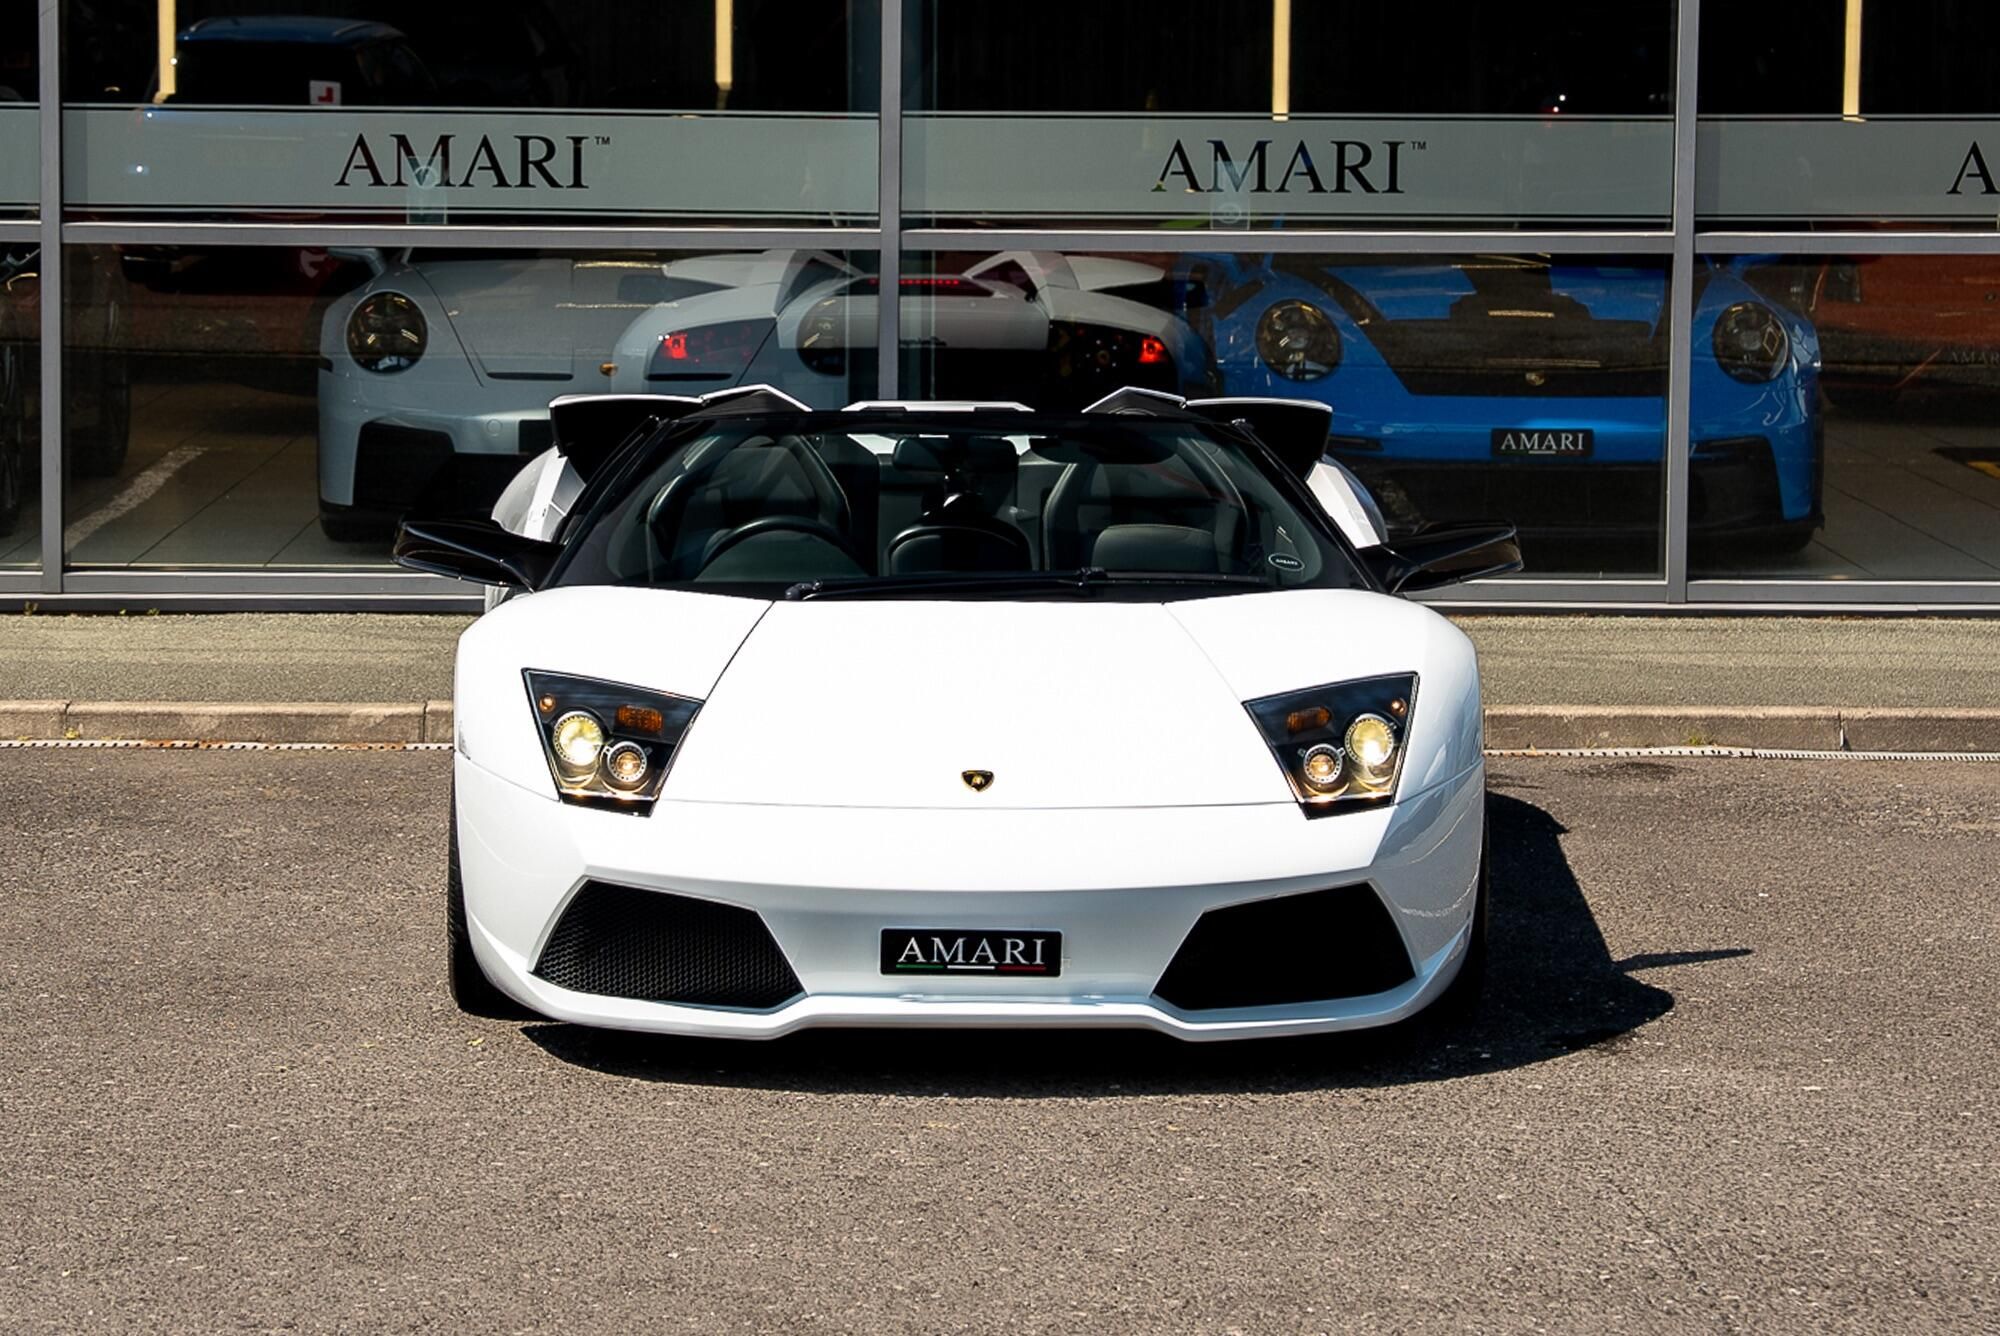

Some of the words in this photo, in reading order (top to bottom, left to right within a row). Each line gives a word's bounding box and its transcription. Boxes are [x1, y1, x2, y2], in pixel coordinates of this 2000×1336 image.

[334, 133, 588, 189] AMARI
[1151, 138, 1406, 194] AMARI
[1946, 141, 2000, 195] A
[1500, 432, 1584, 450] AMARI
[897, 936, 1046, 965] AMARI
